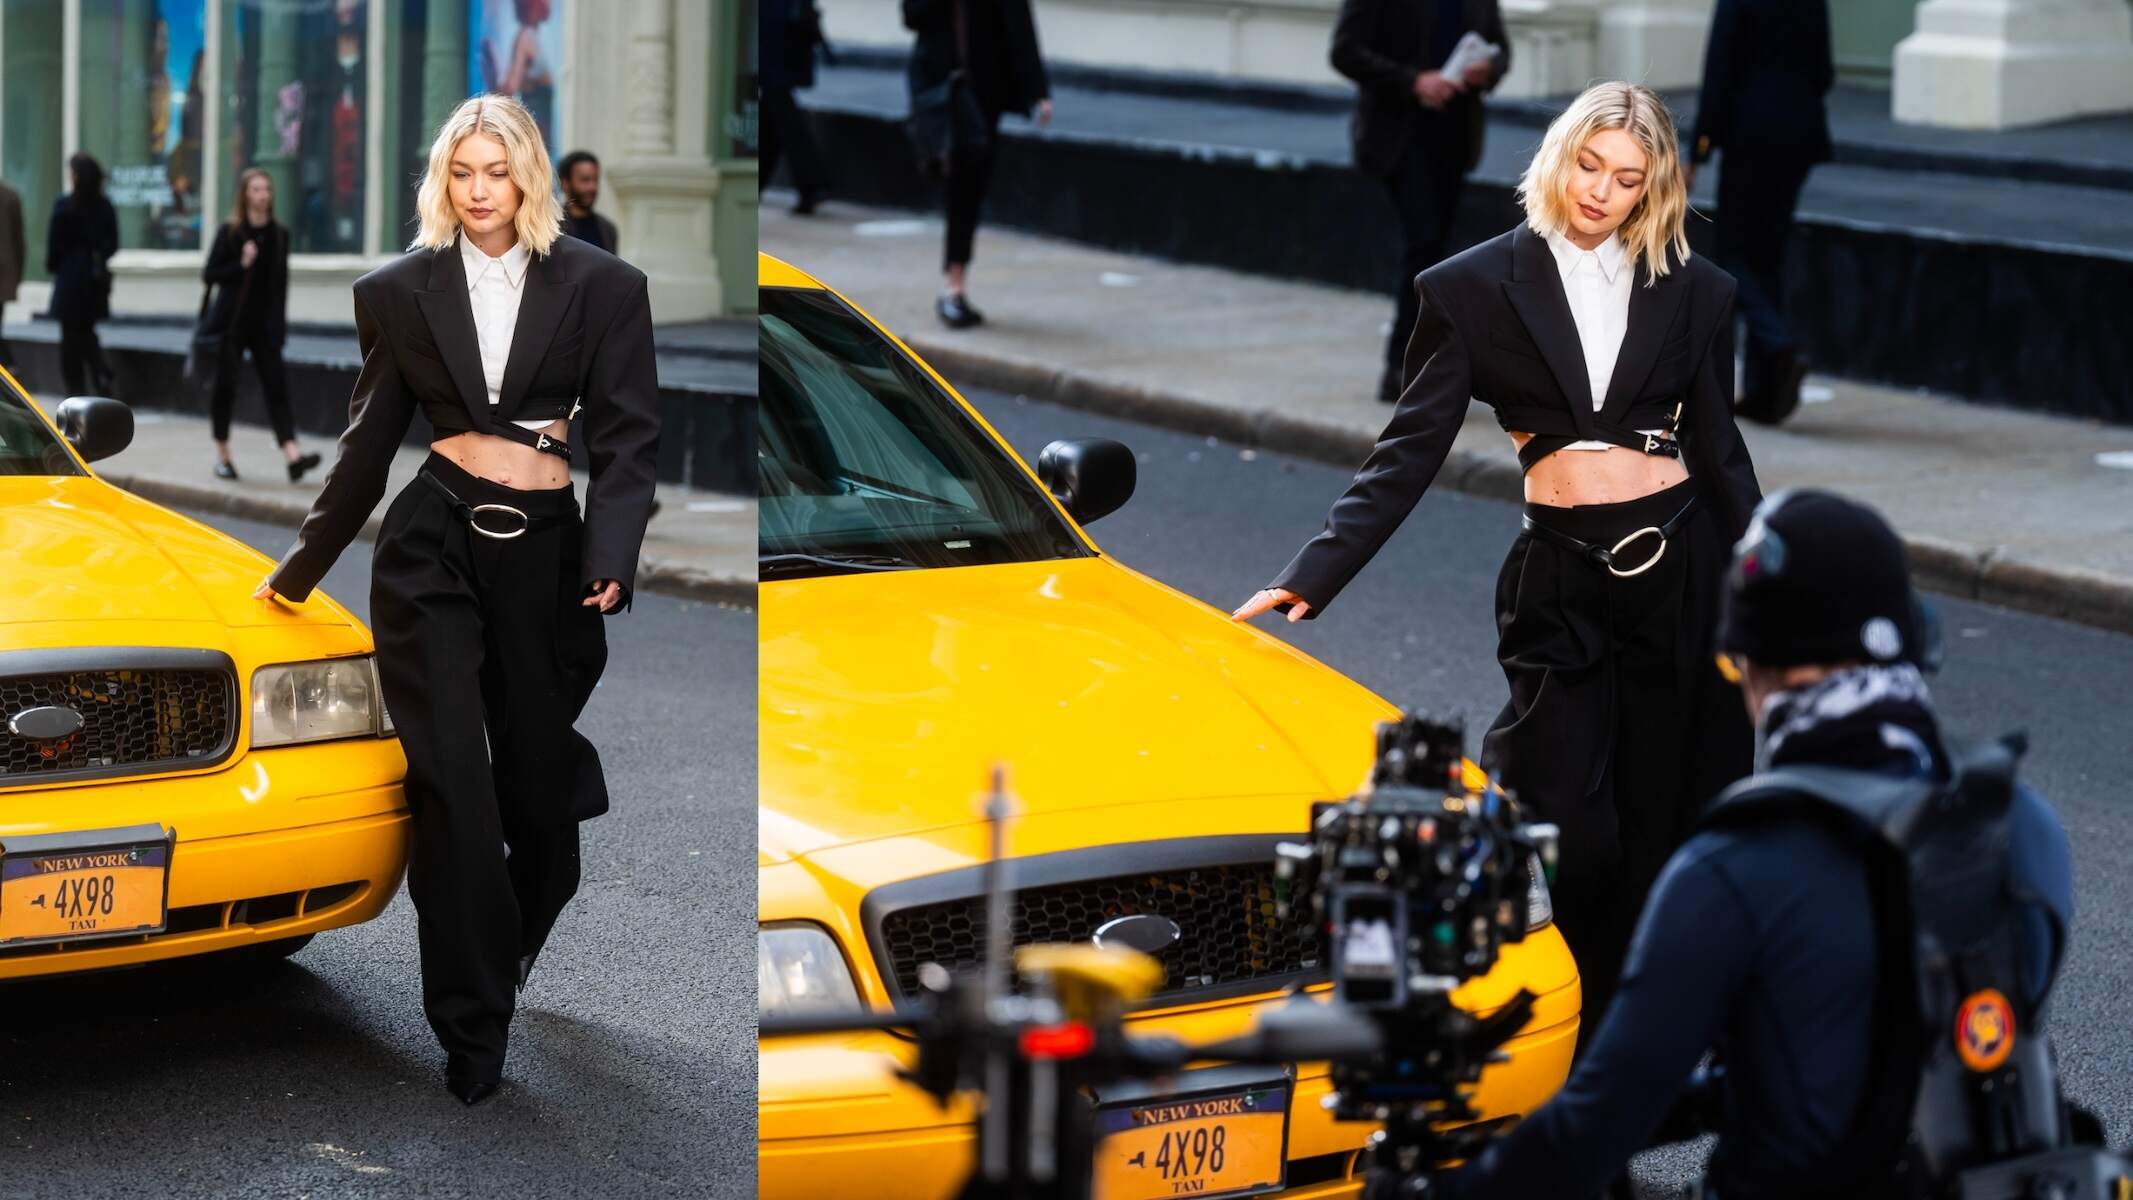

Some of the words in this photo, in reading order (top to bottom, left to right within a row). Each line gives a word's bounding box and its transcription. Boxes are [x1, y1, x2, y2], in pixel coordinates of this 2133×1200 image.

[43, 858, 82, 873] NEW
[87, 853, 128, 868] YORK
[54, 875, 114, 918] 4X98
[69, 919, 97, 931] TAXI
[1143, 1105, 1190, 1125] NEW
[1194, 1098, 1243, 1117] YORK
[1155, 1125, 1225, 1180] 4X98
[1172, 1179, 1204, 1193] TAXI
